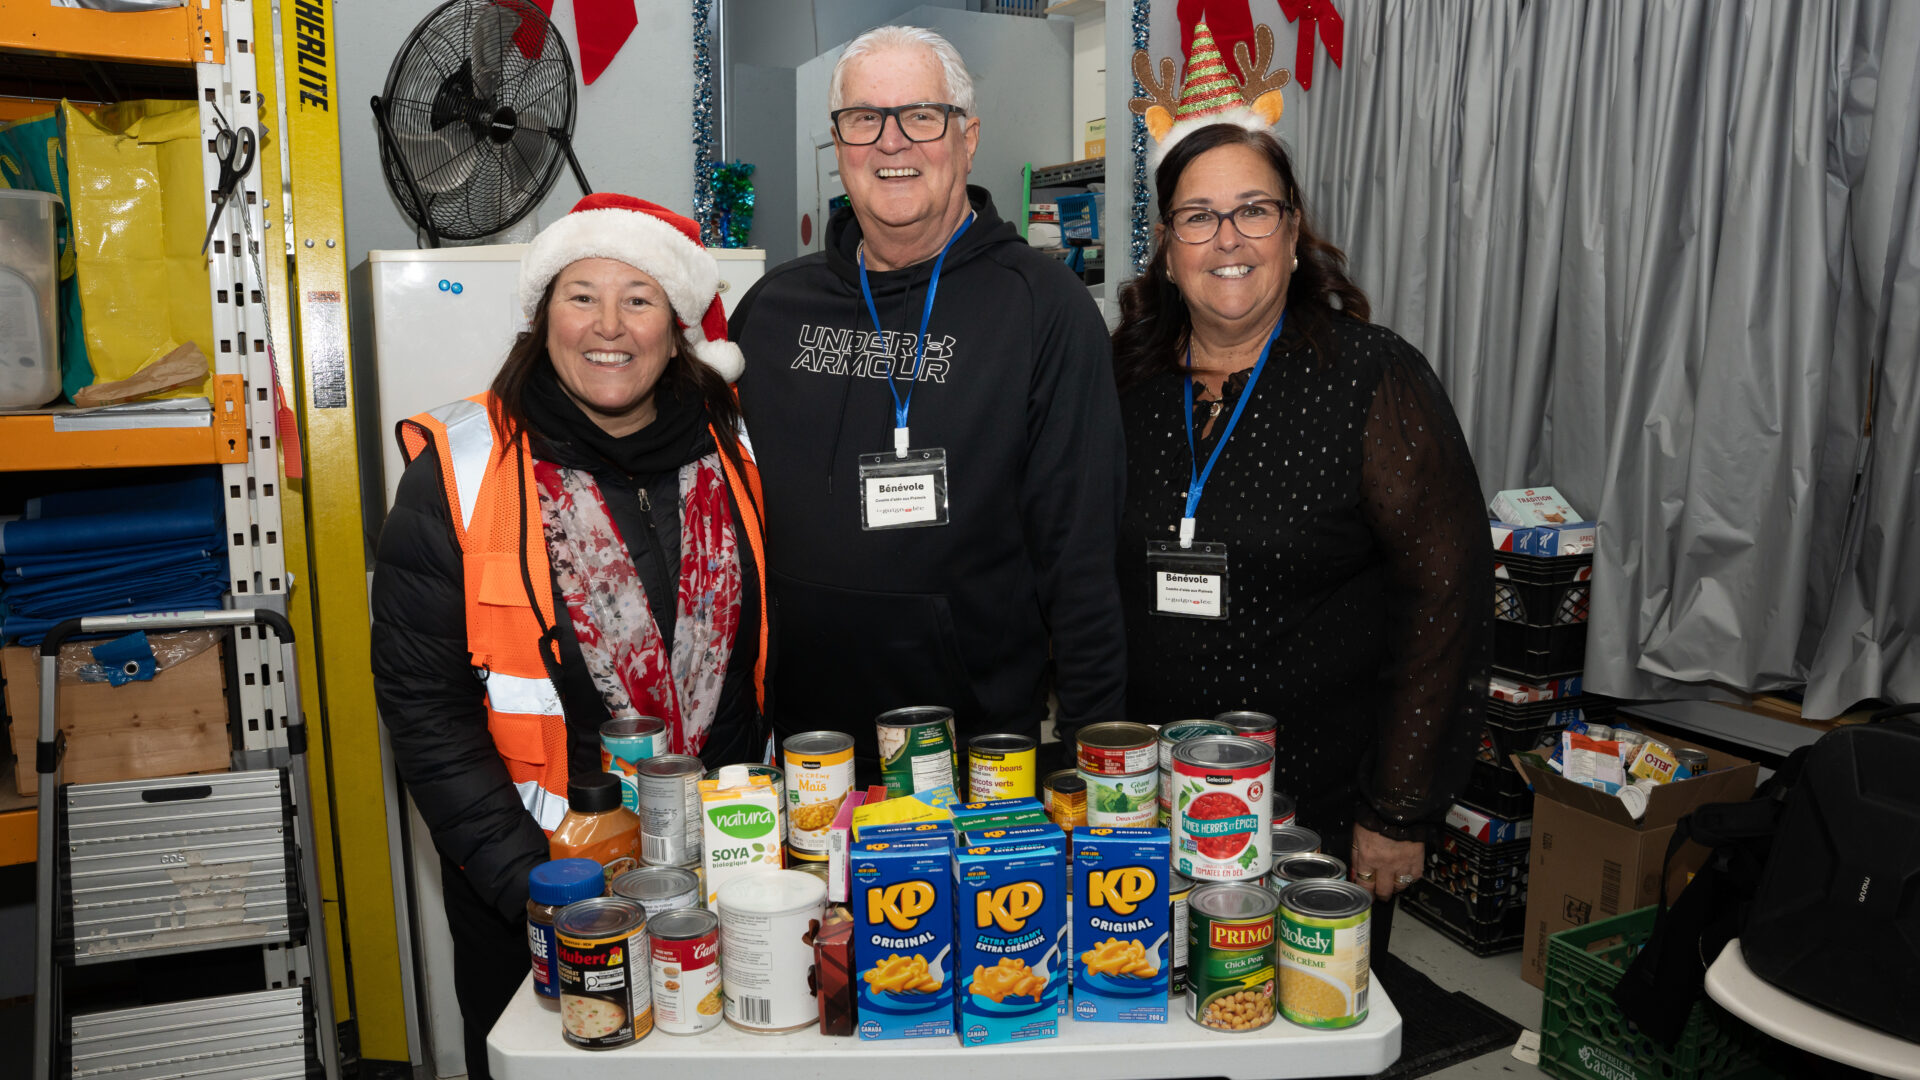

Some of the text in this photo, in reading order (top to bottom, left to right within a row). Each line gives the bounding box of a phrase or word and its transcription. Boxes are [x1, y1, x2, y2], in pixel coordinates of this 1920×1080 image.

[798, 324, 918, 357] UNDER
[790, 347, 950, 383] ARMOUR
[879, 482, 924, 493] Bénévole
[1517, 495, 1553, 503] TRADITION
[1166, 573, 1209, 584] Bénévole
[978, 764, 998, 772] green
[1000, 764, 1023, 772] beans
[798, 779, 827, 792] Maïs
[717, 810, 771, 828] natura
[1183, 817, 1200, 833] FINES
[1201, 822, 1228, 833] HERBES
[1235, 818, 1257, 832] ÉPICES
[712, 847, 749, 862] SOYA
[713, 860, 747, 869] biologique
[1195, 867, 1220, 877] TOMATES
[1222, 869, 1231, 877] EN
[1091, 917, 1153, 932] ORIGINAL
[871, 931, 935, 948] ORIGINAL
[979, 928, 1041, 945] EXTRA CREAMY
[1215, 924, 1272, 945] PRIMO
[1280, 919, 1331, 954] Stokely
[976, 935, 1045, 953] EXTRA CRÉMEUX
[559, 946, 607, 965] Hubert
[1225, 960, 1246, 969] Chick
[1248, 954, 1264, 965] Peas
[1296, 956, 1326, 968] CRÈME
